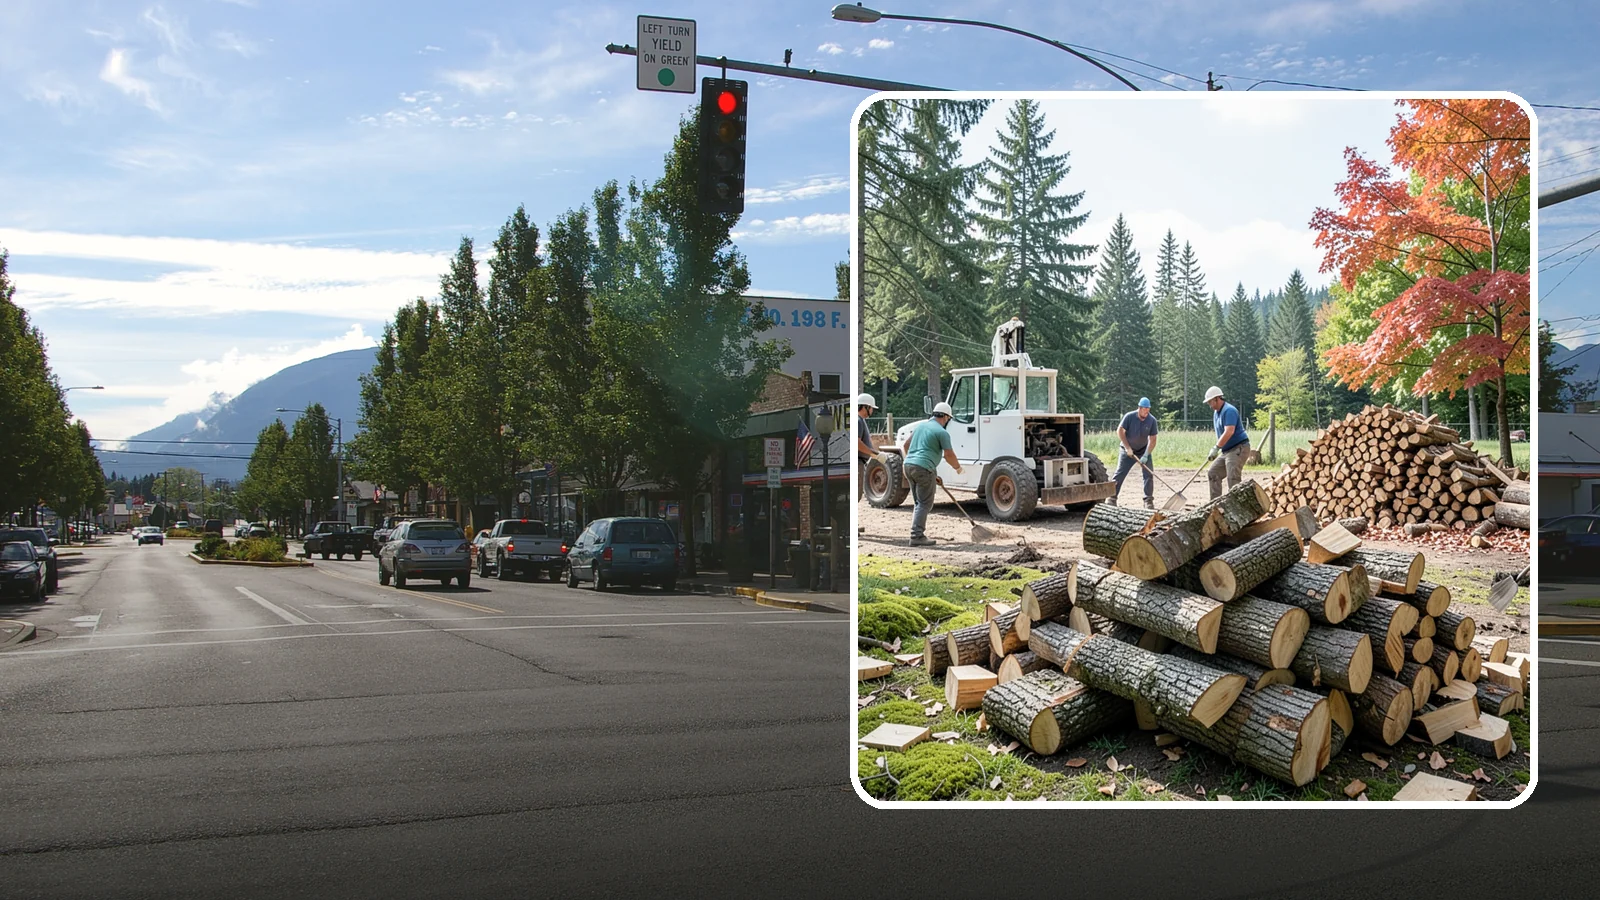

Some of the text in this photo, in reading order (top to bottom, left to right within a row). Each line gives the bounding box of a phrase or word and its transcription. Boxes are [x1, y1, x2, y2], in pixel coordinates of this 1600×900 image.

[642, 23, 690, 37] LEFT TURN
[652, 38, 682, 52] YIELD
[644, 53, 689, 66] ON GREEN
[791, 309, 826, 328] 198
[831, 311, 847, 329] F.
